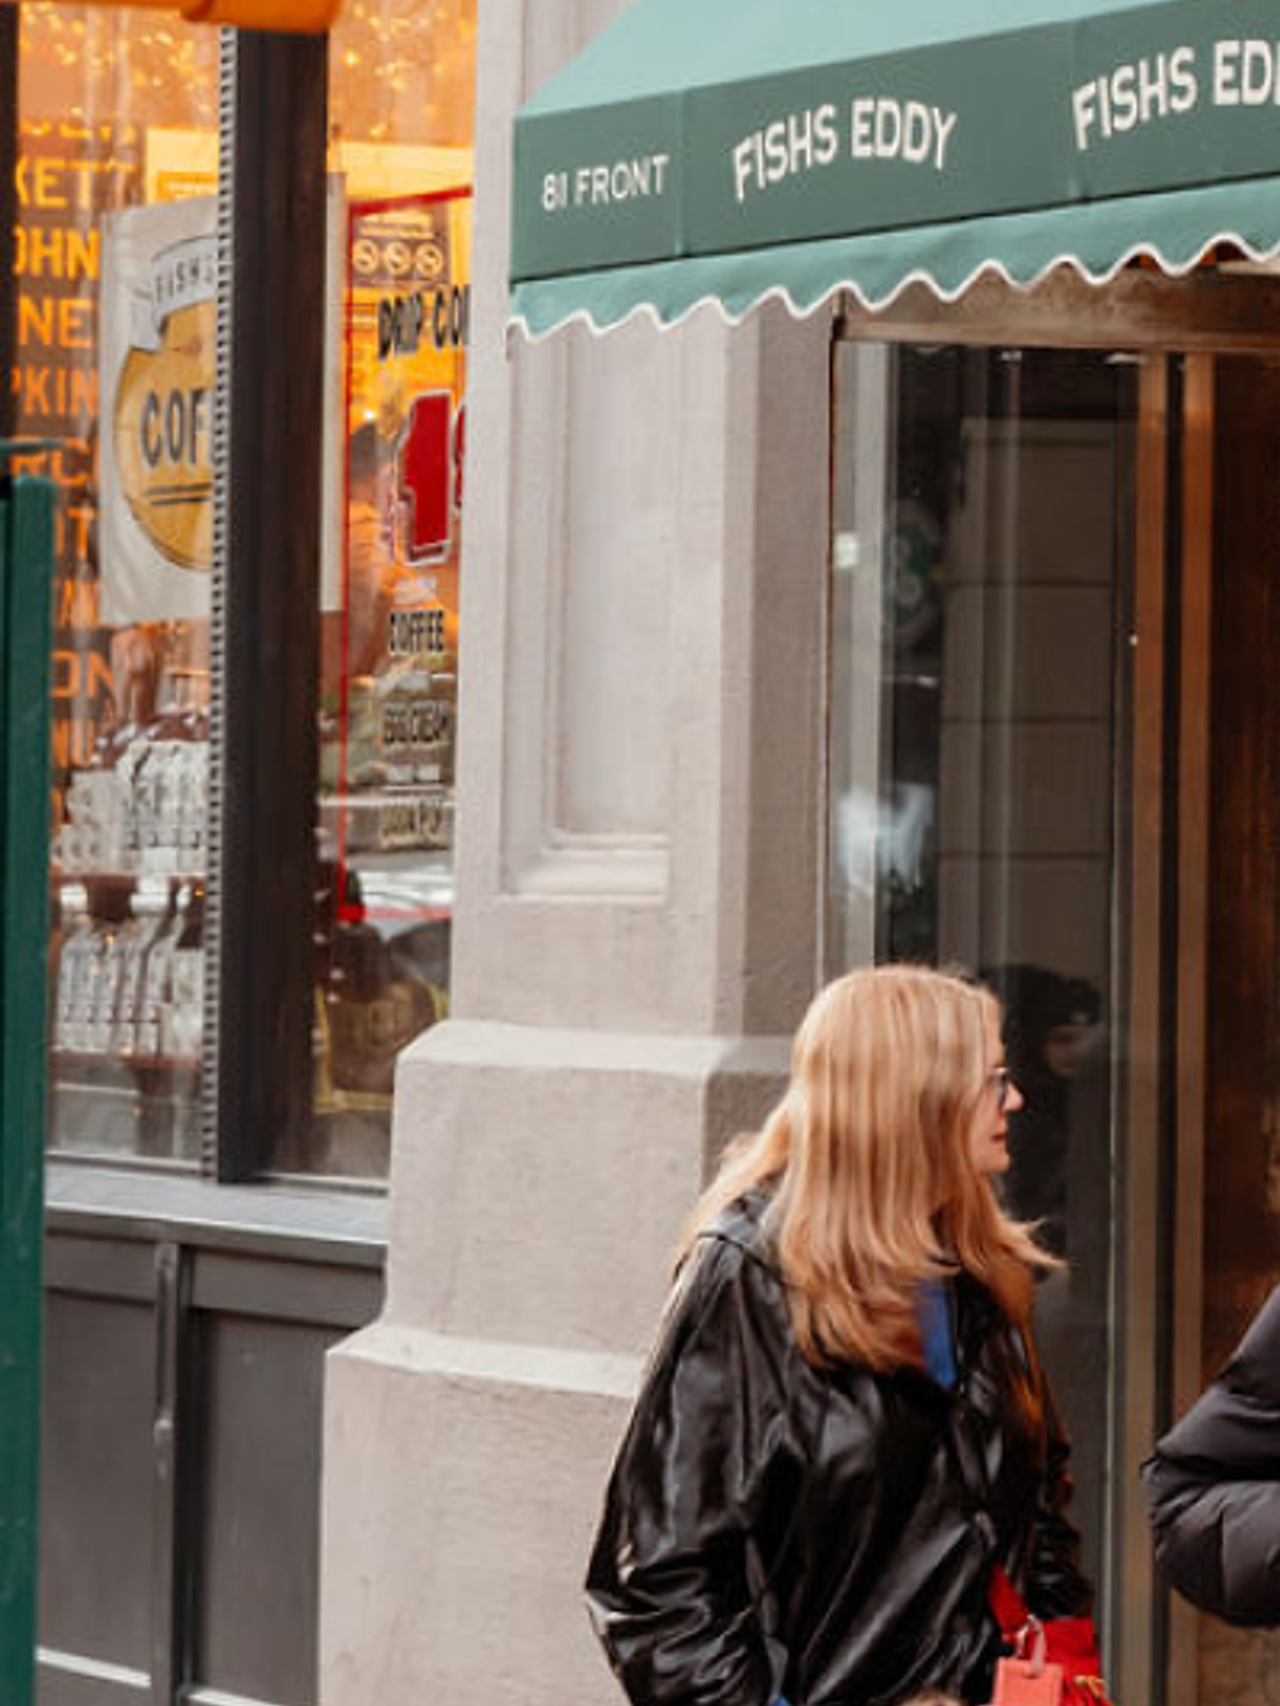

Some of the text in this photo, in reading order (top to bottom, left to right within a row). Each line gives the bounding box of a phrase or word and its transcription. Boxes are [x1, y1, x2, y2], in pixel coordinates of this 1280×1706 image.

[1071, 47, 1196, 151] FISHS
[542, 154, 669, 211] 81 FRONT
[733, 97, 957, 203] FISHS EDDY
[378, 291, 423, 361] DRIP
